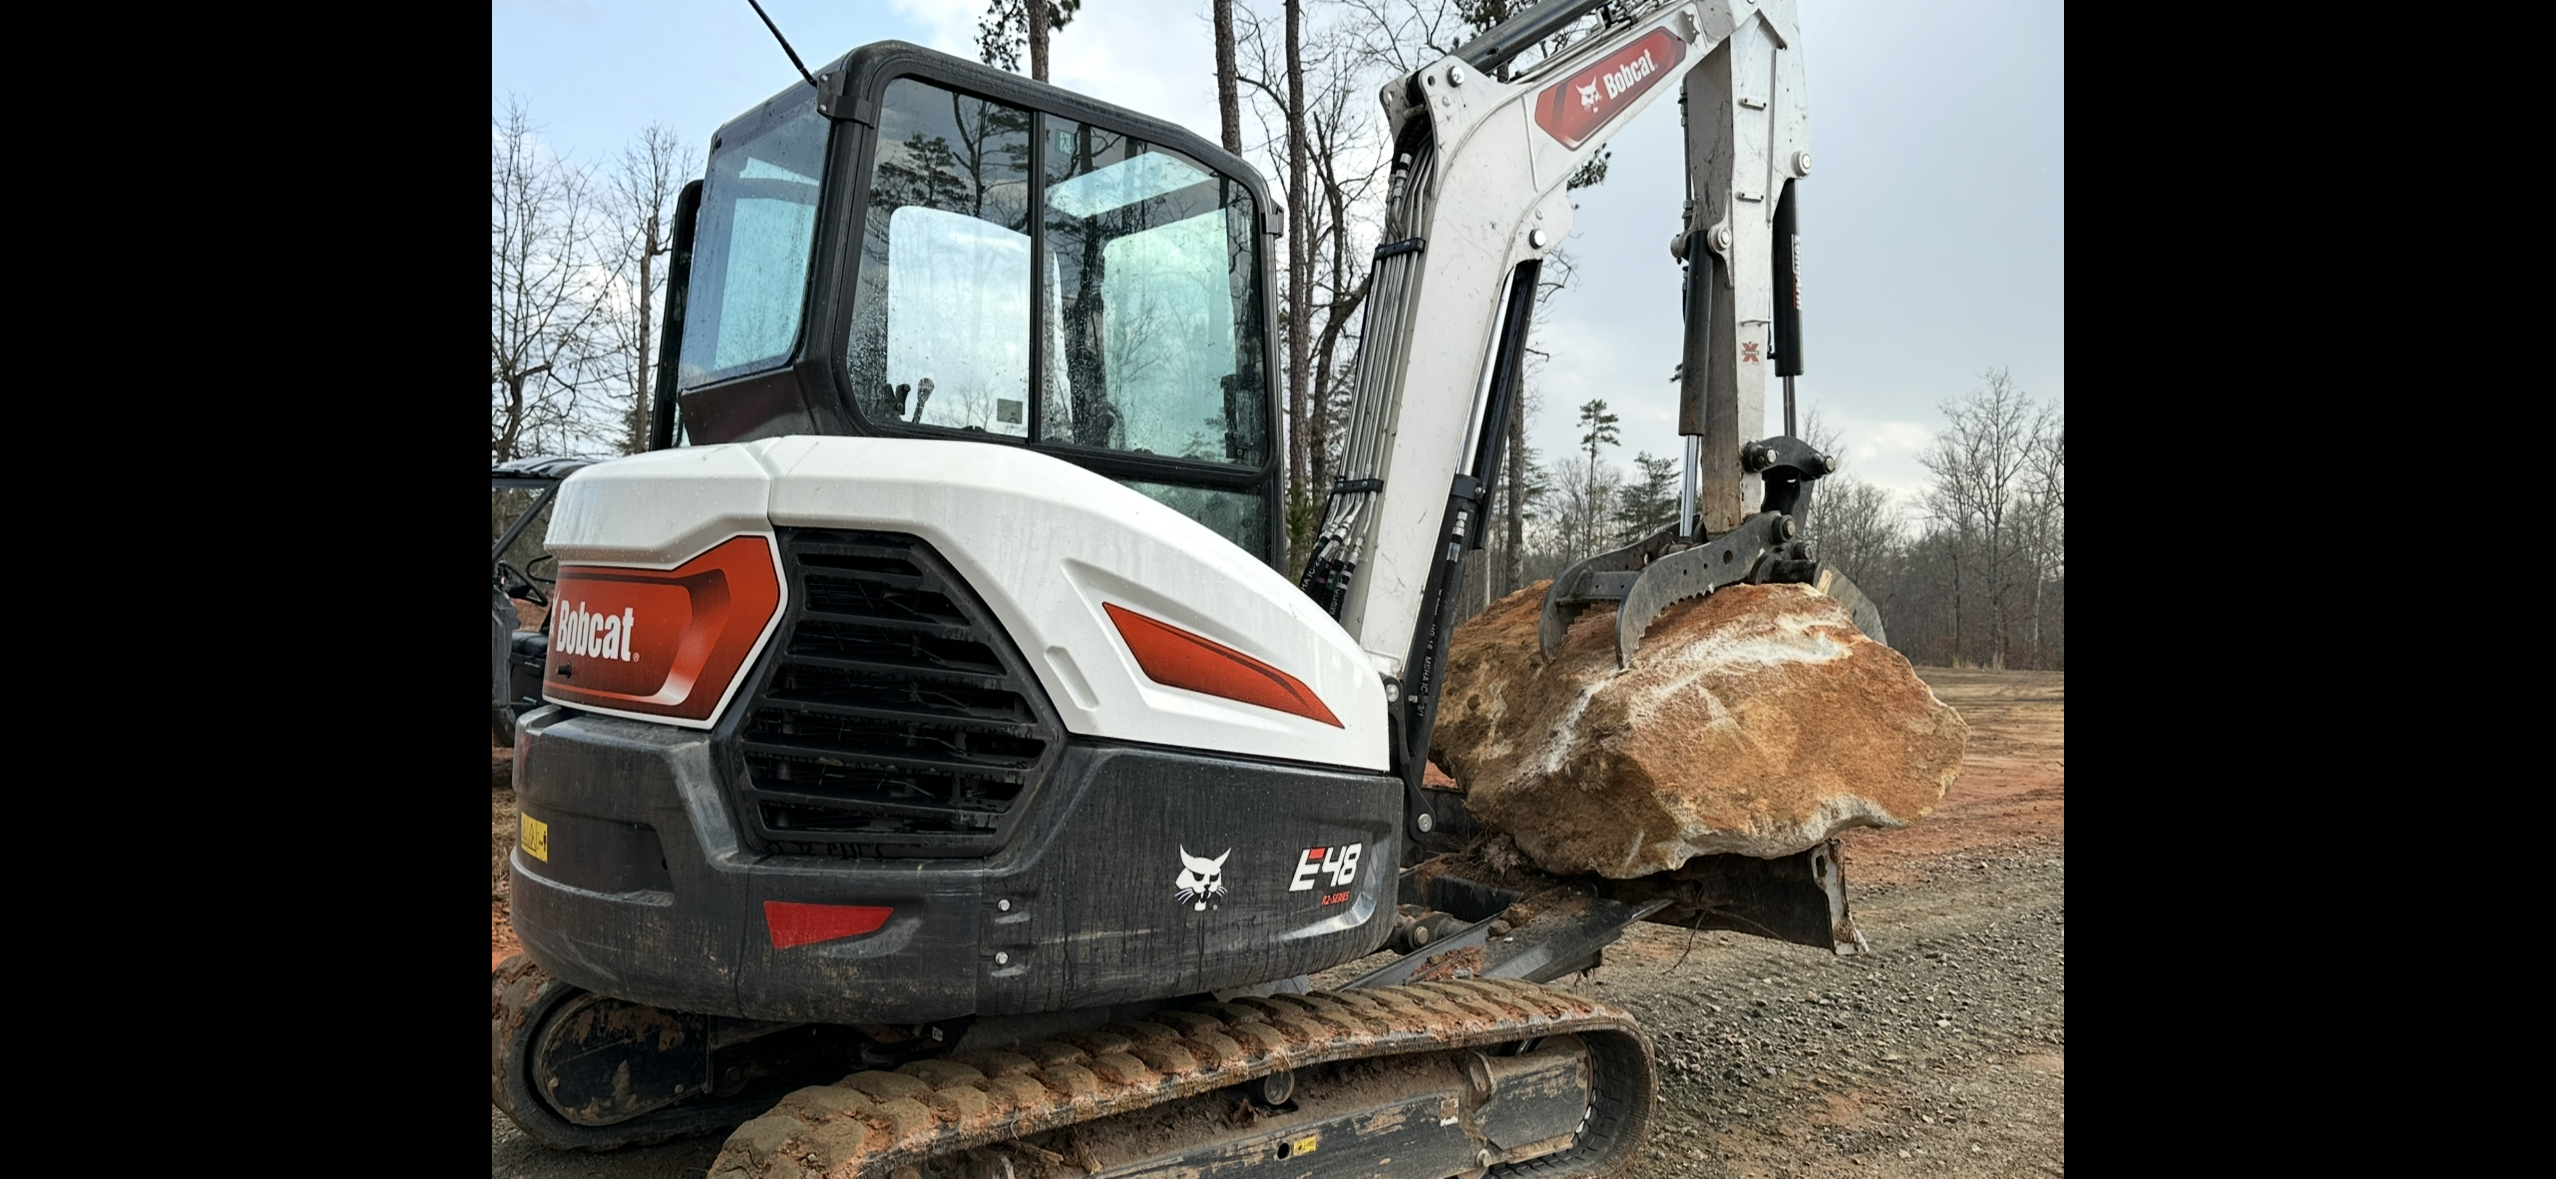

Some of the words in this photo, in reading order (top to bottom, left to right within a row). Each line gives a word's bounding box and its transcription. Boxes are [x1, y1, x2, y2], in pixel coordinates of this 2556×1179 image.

[1602, 48, 1656, 101] Bobcat
[555, 600, 634, 662] Bobcat
[1422, 656, 1432, 683] MSHA
[1289, 842, 1362, 891] E48
[1321, 890, 1350, 905] R2-SERIES
